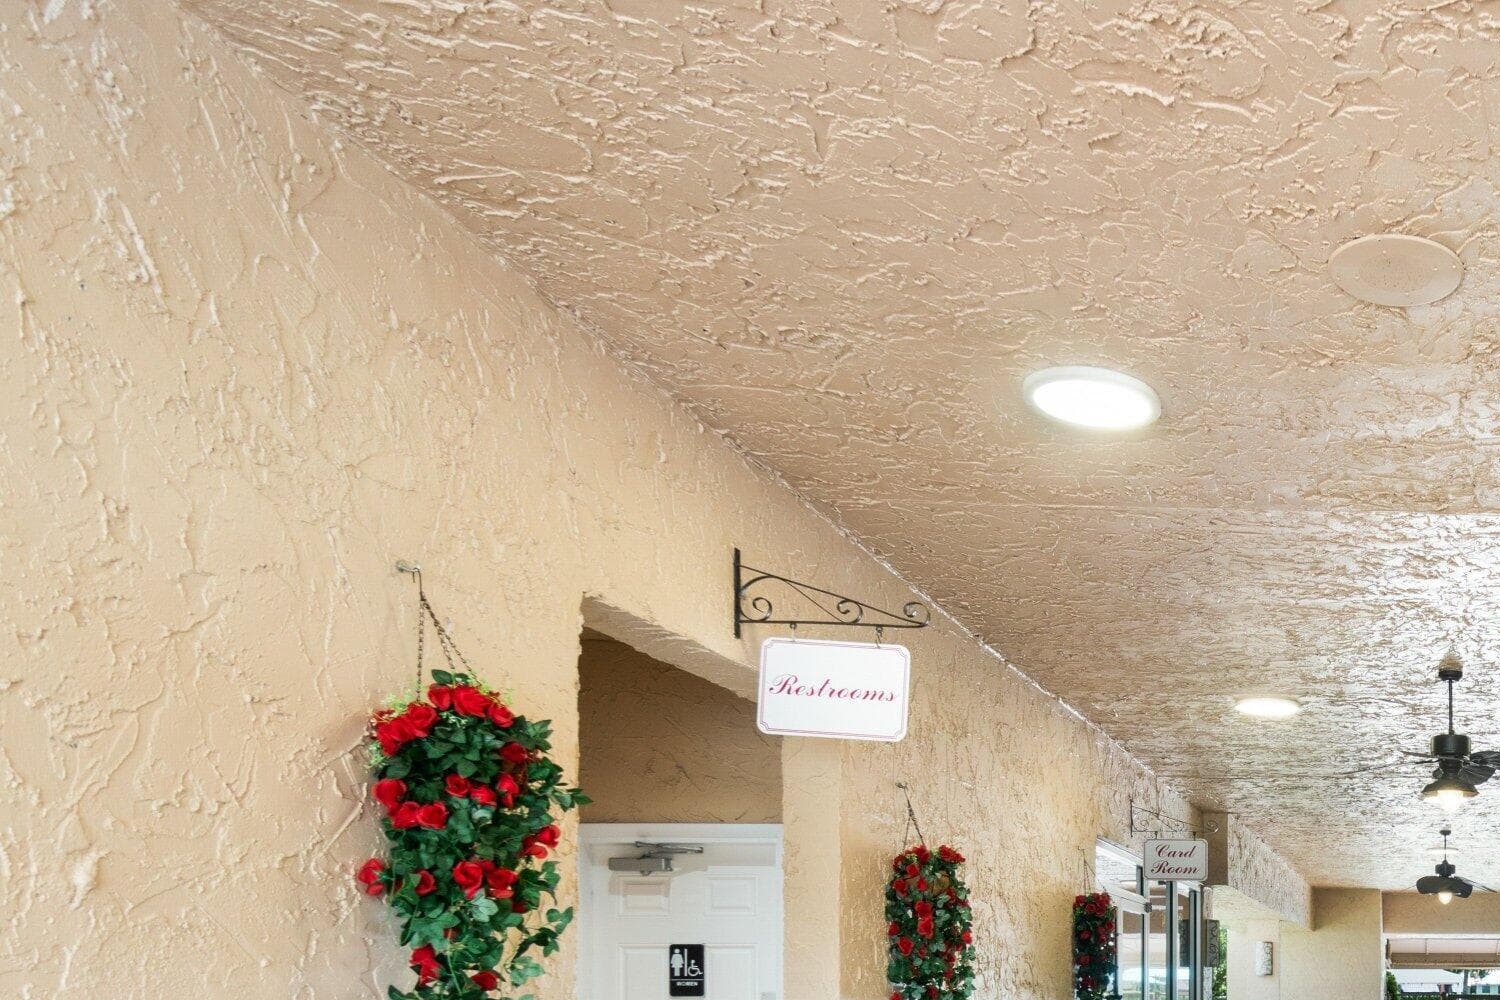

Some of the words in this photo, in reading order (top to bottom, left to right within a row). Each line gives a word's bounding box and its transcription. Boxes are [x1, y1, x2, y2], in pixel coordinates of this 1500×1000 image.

[768, 673, 898, 703] Restrooms
[1155, 844, 1197, 858] Card
[1150, 860, 1200, 874] Room
